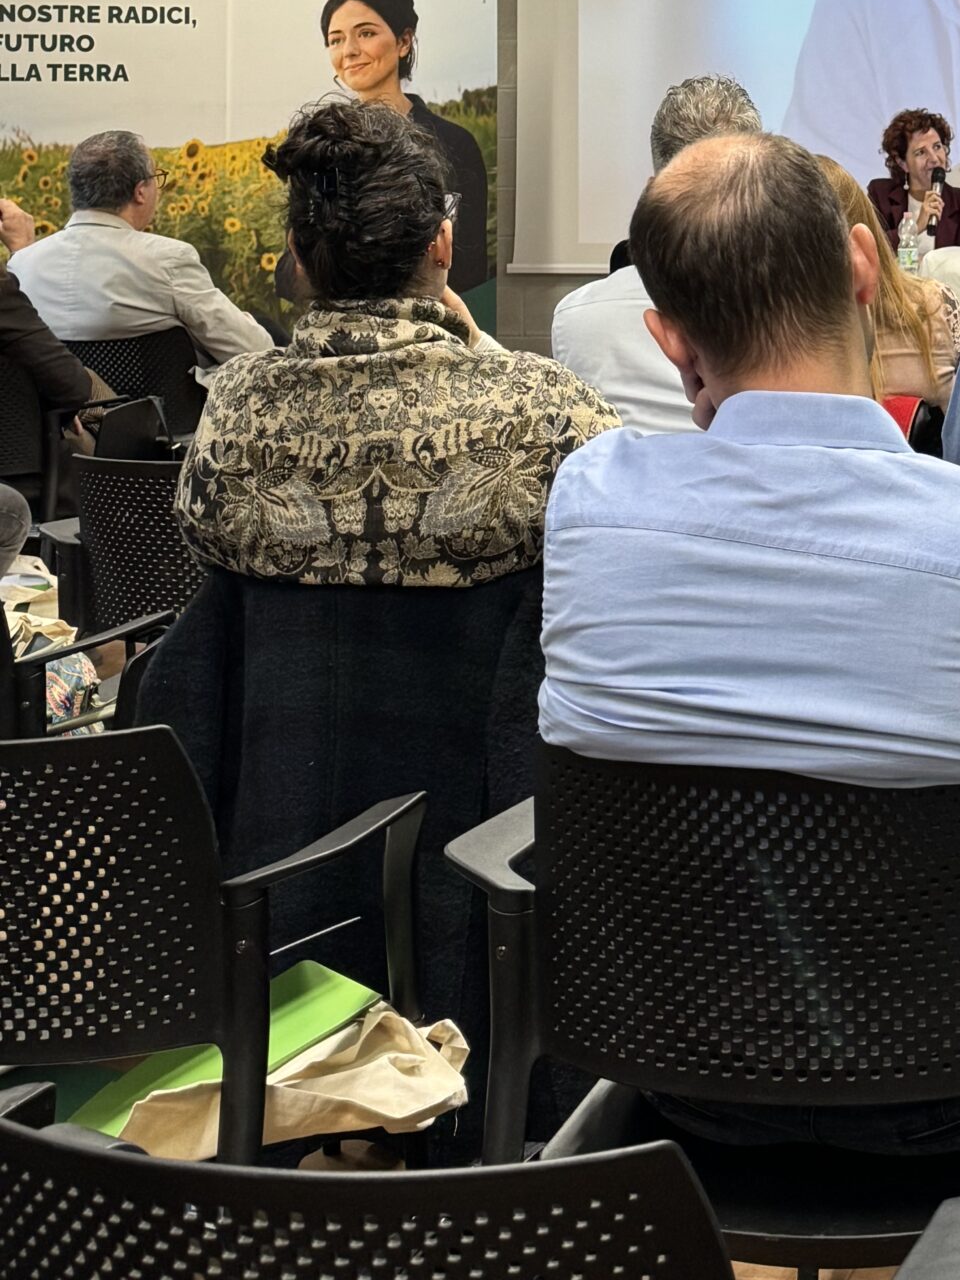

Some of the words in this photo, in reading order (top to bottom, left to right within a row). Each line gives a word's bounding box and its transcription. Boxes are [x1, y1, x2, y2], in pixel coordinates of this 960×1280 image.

[0, 4, 101, 23] NOSTRE
[107, 5, 197, 29] RADICI,
[47, 63, 129, 82] TERRA
